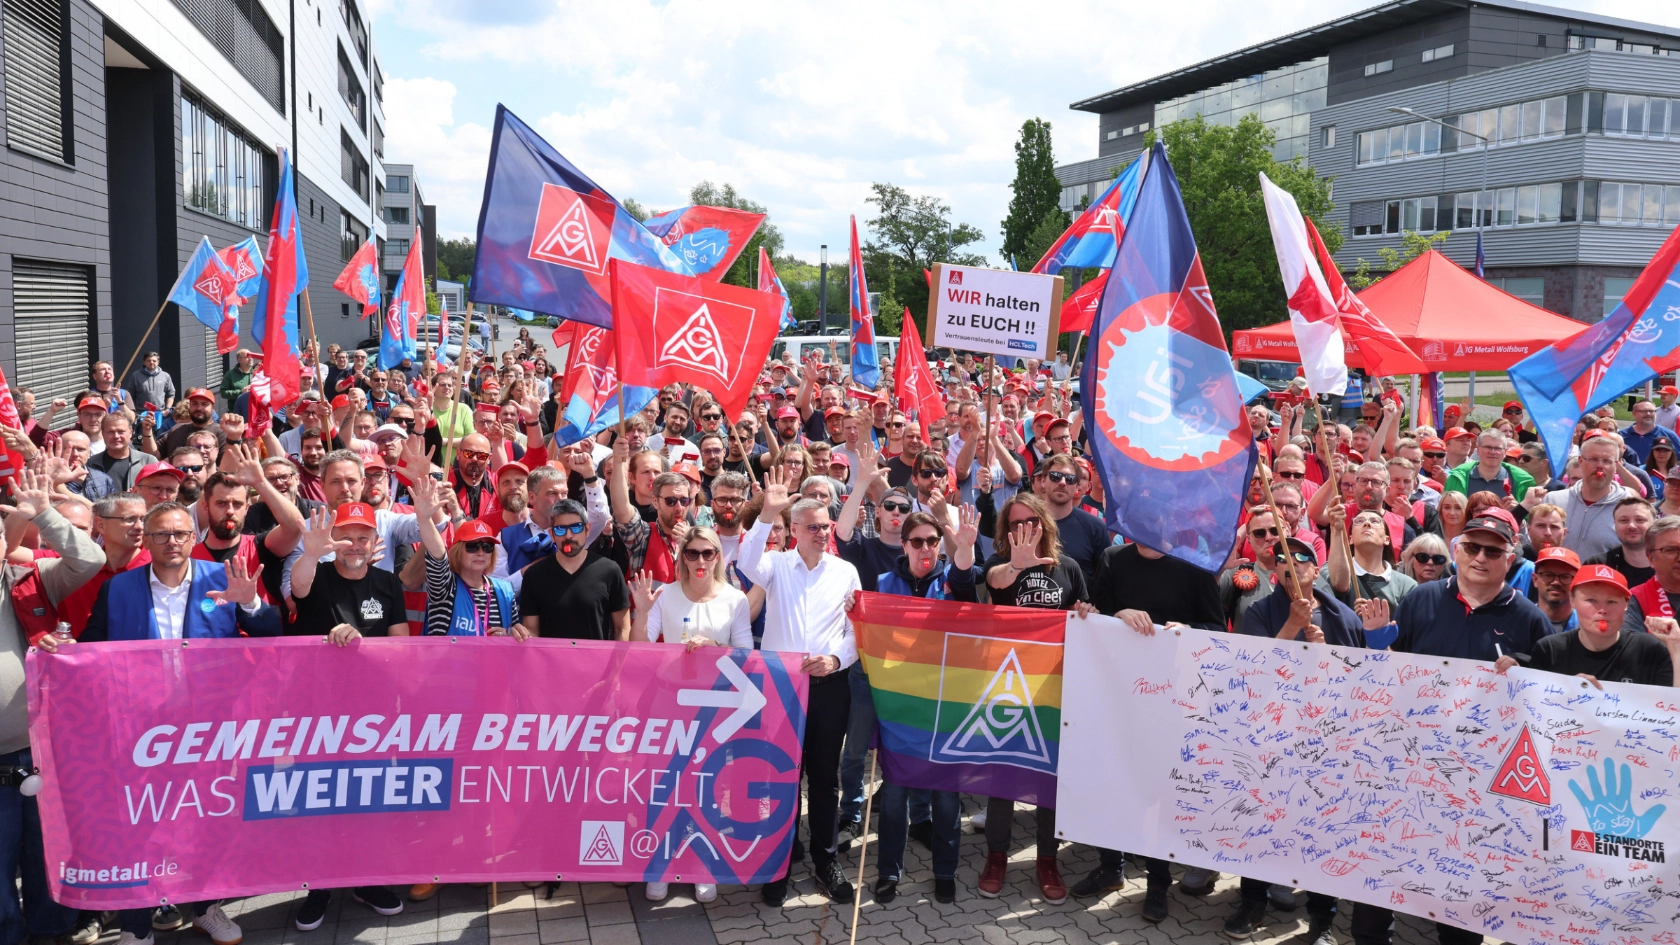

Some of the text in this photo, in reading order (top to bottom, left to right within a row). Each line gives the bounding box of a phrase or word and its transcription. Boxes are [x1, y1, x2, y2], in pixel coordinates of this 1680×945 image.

[948, 288, 1040, 312] WIR halten
[947, 314, 966, 326] zu
[970, 314, 1020, 333] EUCH
[944, 332, 995, 344] Vertrauensleute
[1009, 340, 1036, 350] HCLTech
[1283, 340, 1299, 348] Wolfs
[1474, 345, 1495, 353] Metall
[1496, 345, 1529, 354] Wolfsburg
[1026, 578, 1049, 589] HOTEL
[1033, 587, 1064, 603] Cleef
[132, 713, 707, 768] GEMEINSAM BEWEGEN,
[124, 765, 718, 825] WAS WEITER ENTWICKELT.
[1592, 820, 1606, 832] to
[1595, 833, 1665, 851] 5 STANDORTE
[1427, 848, 1476, 873] Roman
[1595, 841, 1666, 863] EIN TEAM
[59, 858, 178, 884] igmetall.de
[1434, 862, 1471, 881] Peters
